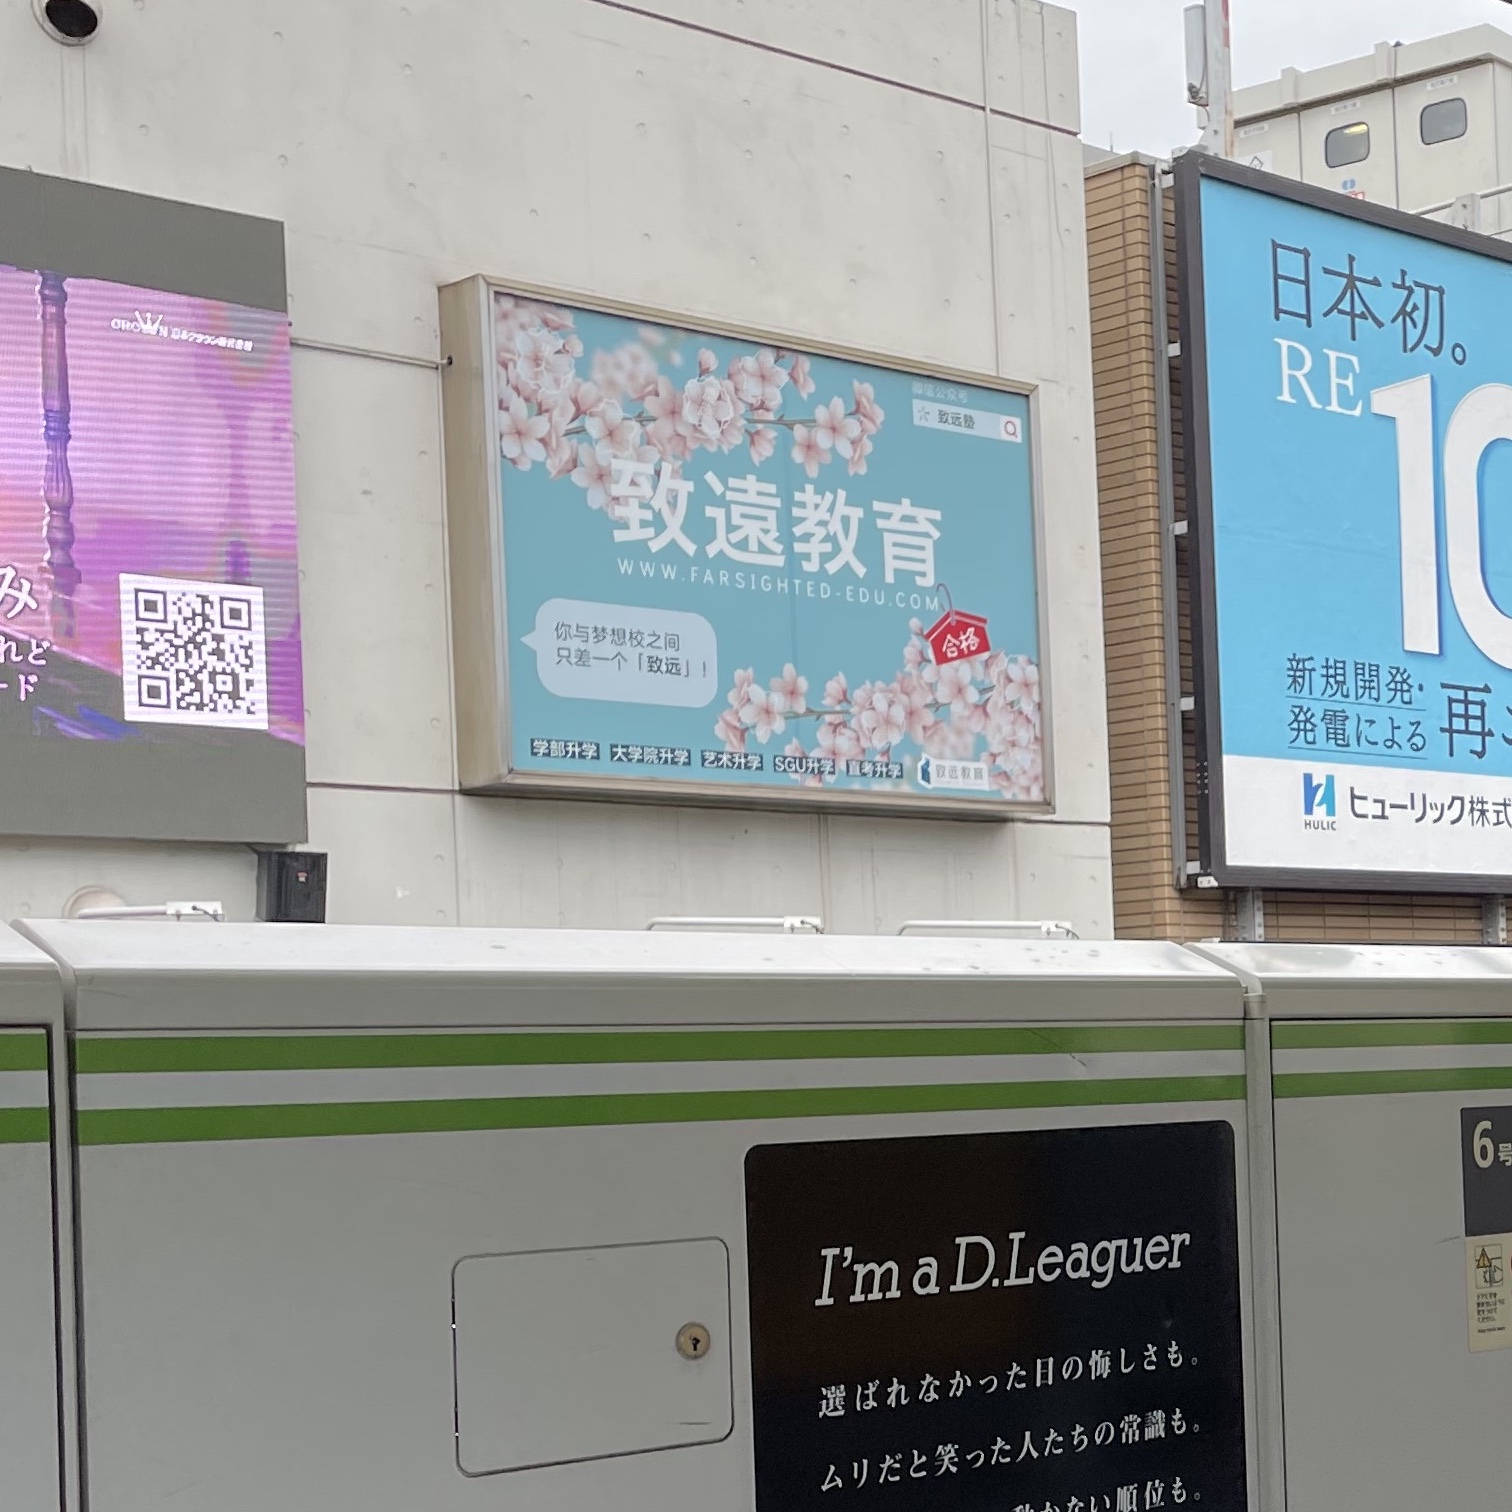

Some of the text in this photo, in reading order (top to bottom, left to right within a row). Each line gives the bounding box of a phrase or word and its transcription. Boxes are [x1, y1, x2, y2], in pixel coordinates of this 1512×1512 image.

[1270, 238, 1467, 366] 日本初。
[609, 458, 942, 588] 致遠教育
[617, 558, 940, 611] WWW.FARSIGHTED-EDU.COM
[554, 621, 680, 652] 你与梦想校之间
[942, 626, 982, 658] 合格
[1288, 704, 1427, 752] 発電による
[533, 739, 598, 759] 学部升学
[611, 744, 690, 765] 大学院升学
[702, 751, 762, 770] 艺术升学
[774, 757, 834, 775] SGU升学
[1304, 820, 1337, 831] HULIC
[815, 1231, 1190, 1307] I'm a D.Leaguer
[818, 1340, 1198, 1419] 選ばれなかった日の悔しさも。
[821, 1407, 1200, 1492] ムリだと笑った人たちの常識も。
